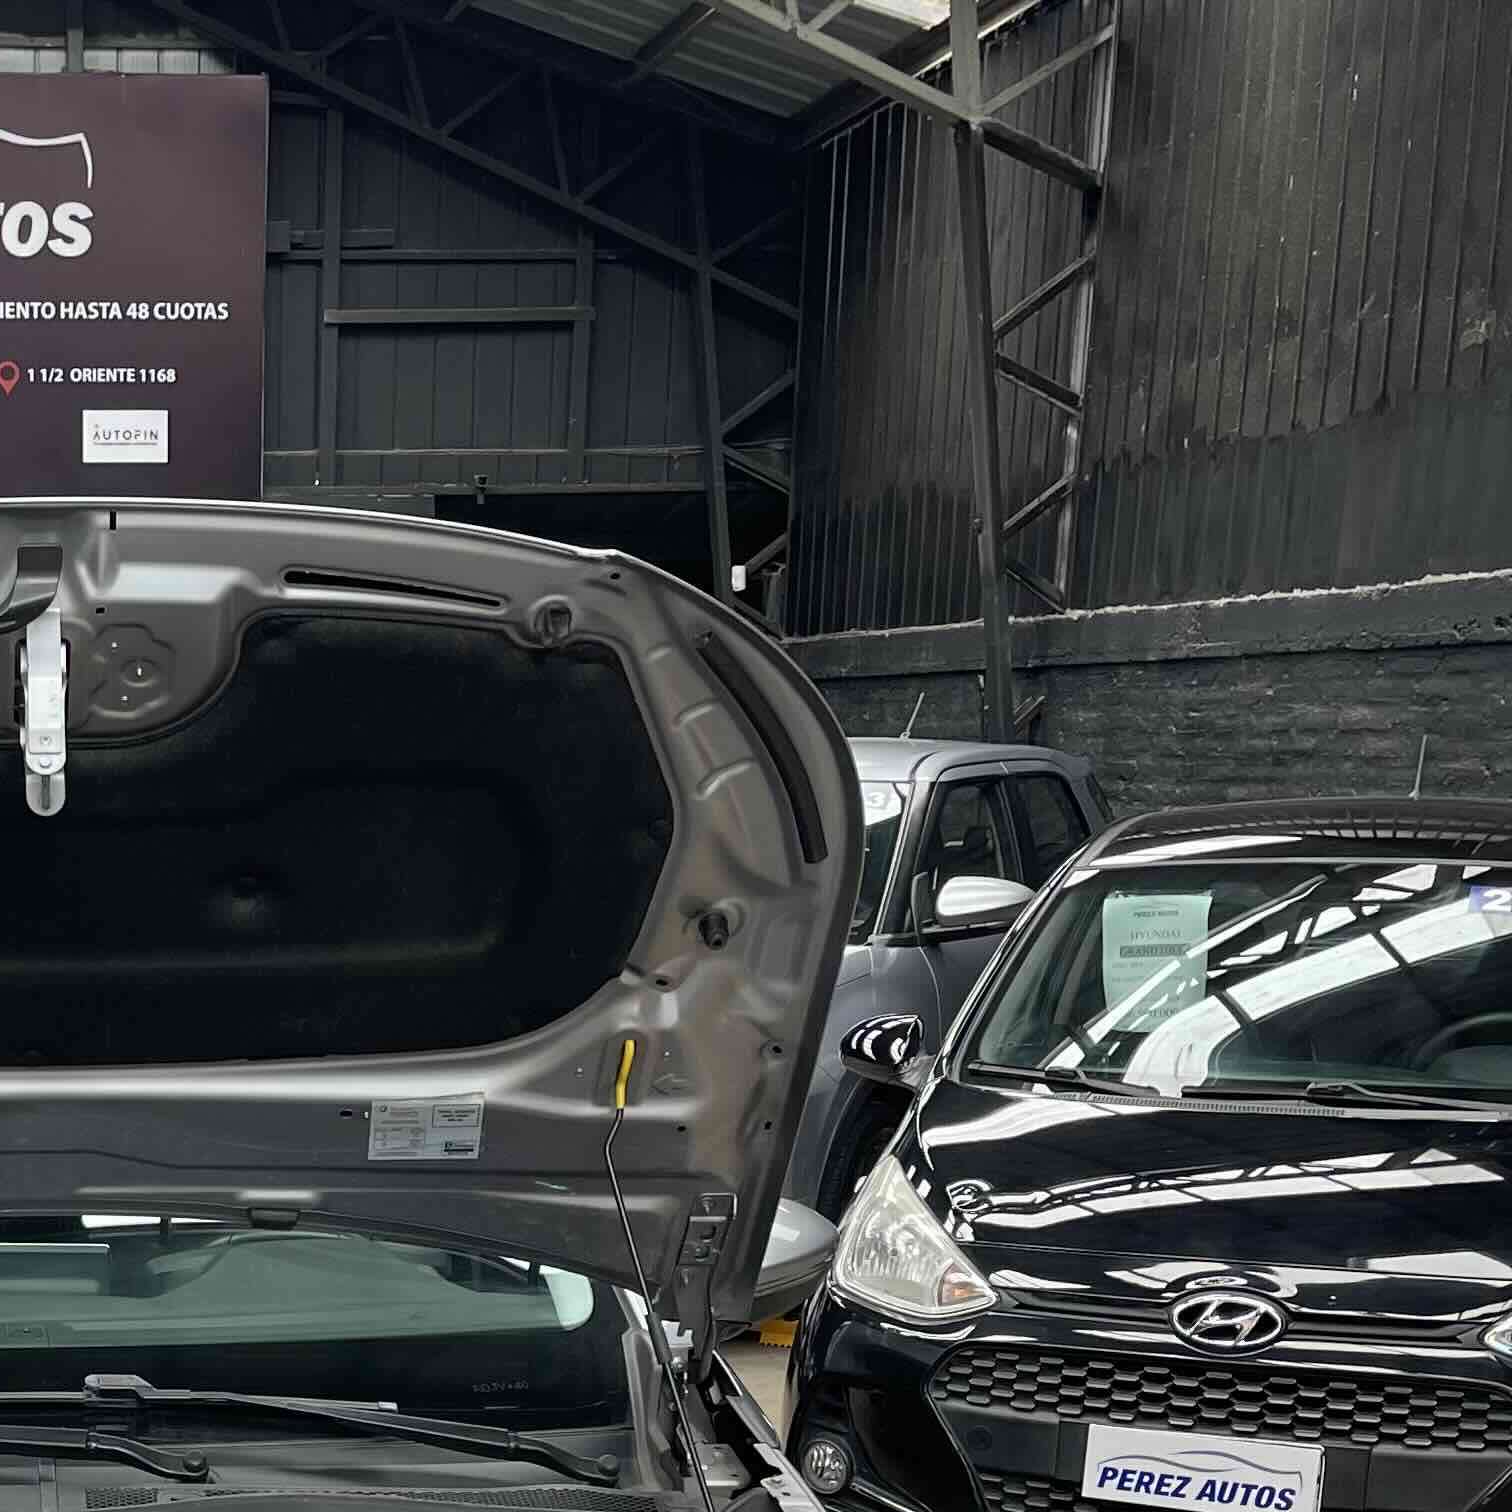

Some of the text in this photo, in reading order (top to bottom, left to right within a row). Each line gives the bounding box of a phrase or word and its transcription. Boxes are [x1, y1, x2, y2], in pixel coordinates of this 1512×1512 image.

[60, 301, 123, 320] HASTA
[126, 302, 150, 320] 48
[153, 302, 229, 320] CUOTAS
[28, 367, 176, 383] 1 1/2 ORIENTE 1168
[93, 429, 159, 441] AUTOFIN
[1097, 1466, 1297, 1512] PEREZ AUTOS
